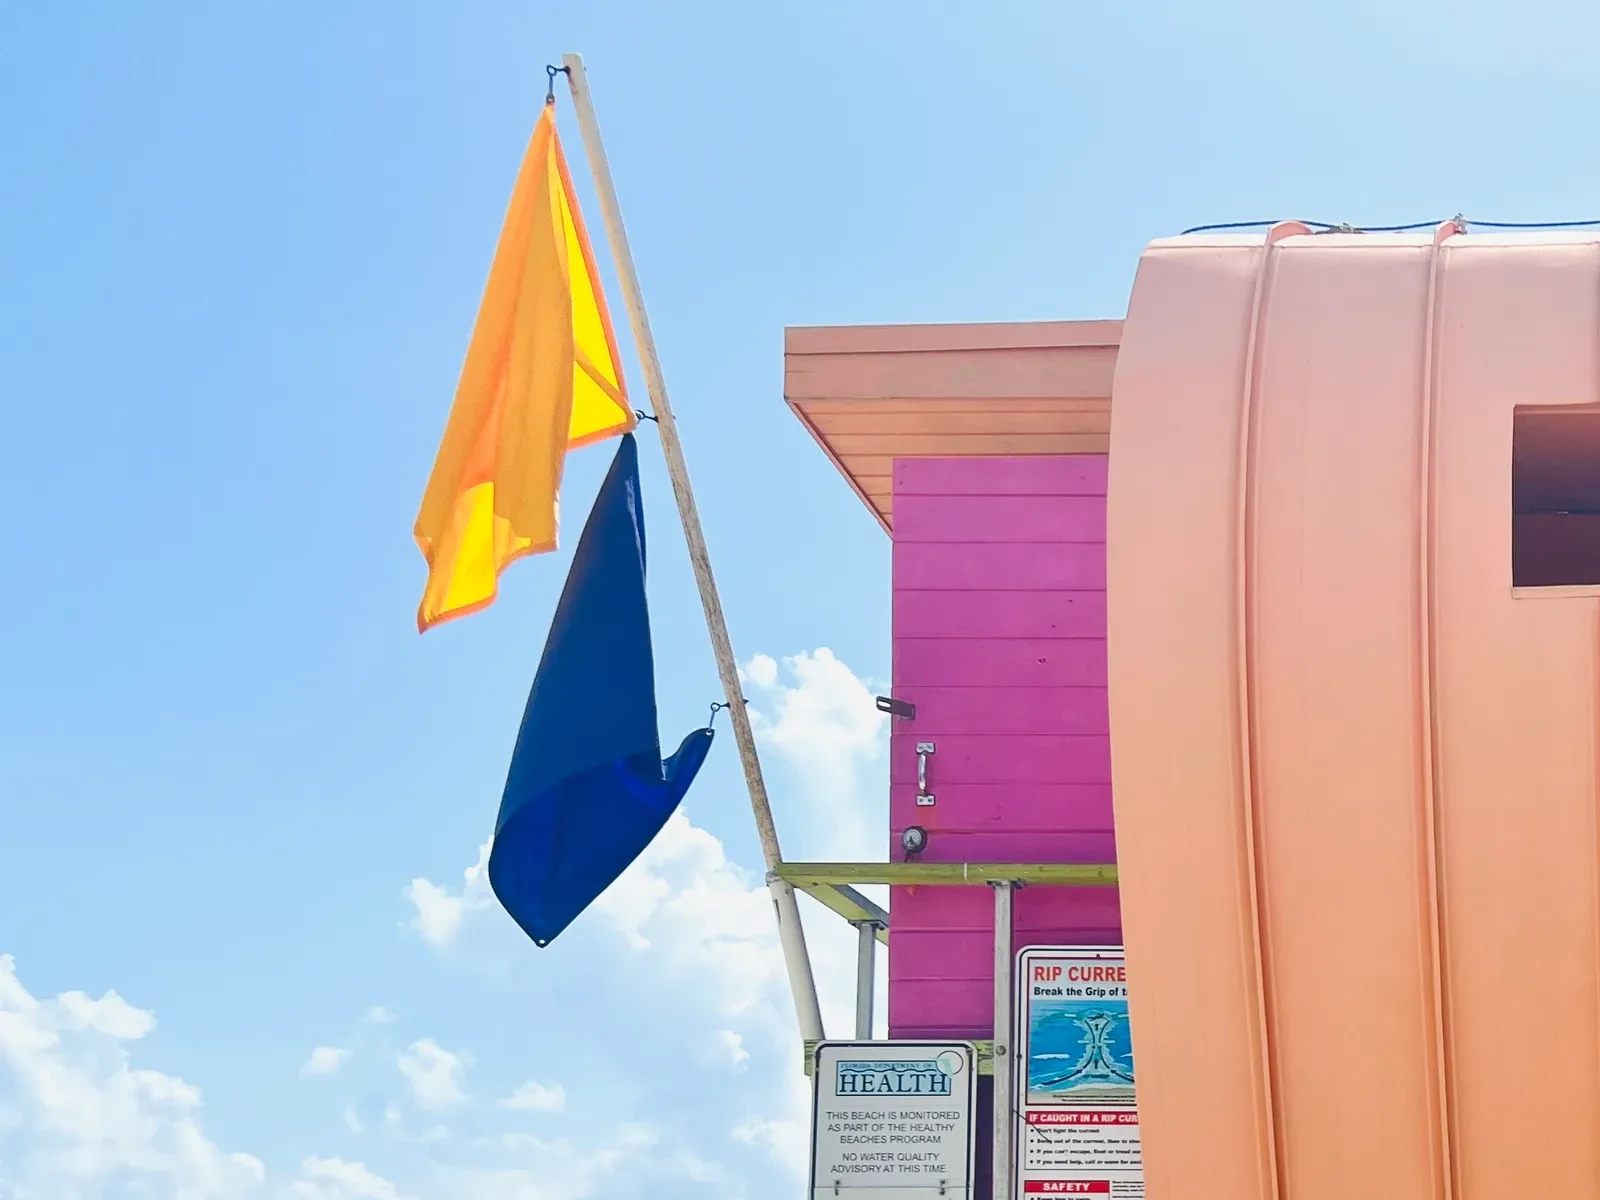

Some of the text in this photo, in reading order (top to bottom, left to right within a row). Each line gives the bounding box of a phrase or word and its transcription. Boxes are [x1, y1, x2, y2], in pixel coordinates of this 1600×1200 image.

[1034, 966, 1063, 981] RIP
[1034, 987, 1063, 996] Break
[1066, 987, 1082, 996] the
[1085, 987, 1106, 998] Grip
[1108, 987, 1119, 996] of
[840, 1074, 948, 1092] HEALTH
[827, 1112, 960, 1120] THIS BEACH IS MONITORED
[1029, 1114, 1039, 1122] IF
[1040, 1114, 1078, 1122] CAUGHT
[1080, 1114, 1090, 1122] IN
[1092, 1114, 1099, 1122] A
[1101, 1114, 1116, 1122] RIP
[828, 1124, 955, 1132] AS PART OF THE HEALTHY
[840, 1136, 941, 1144] BEACHES PROGRAM
[842, 1153, 940, 1161] NO WATER QUALITY
[830, 1165, 946, 1173] ADVISORY AT THIS TIME
[1043, 1183, 1091, 1191] SAFETY
